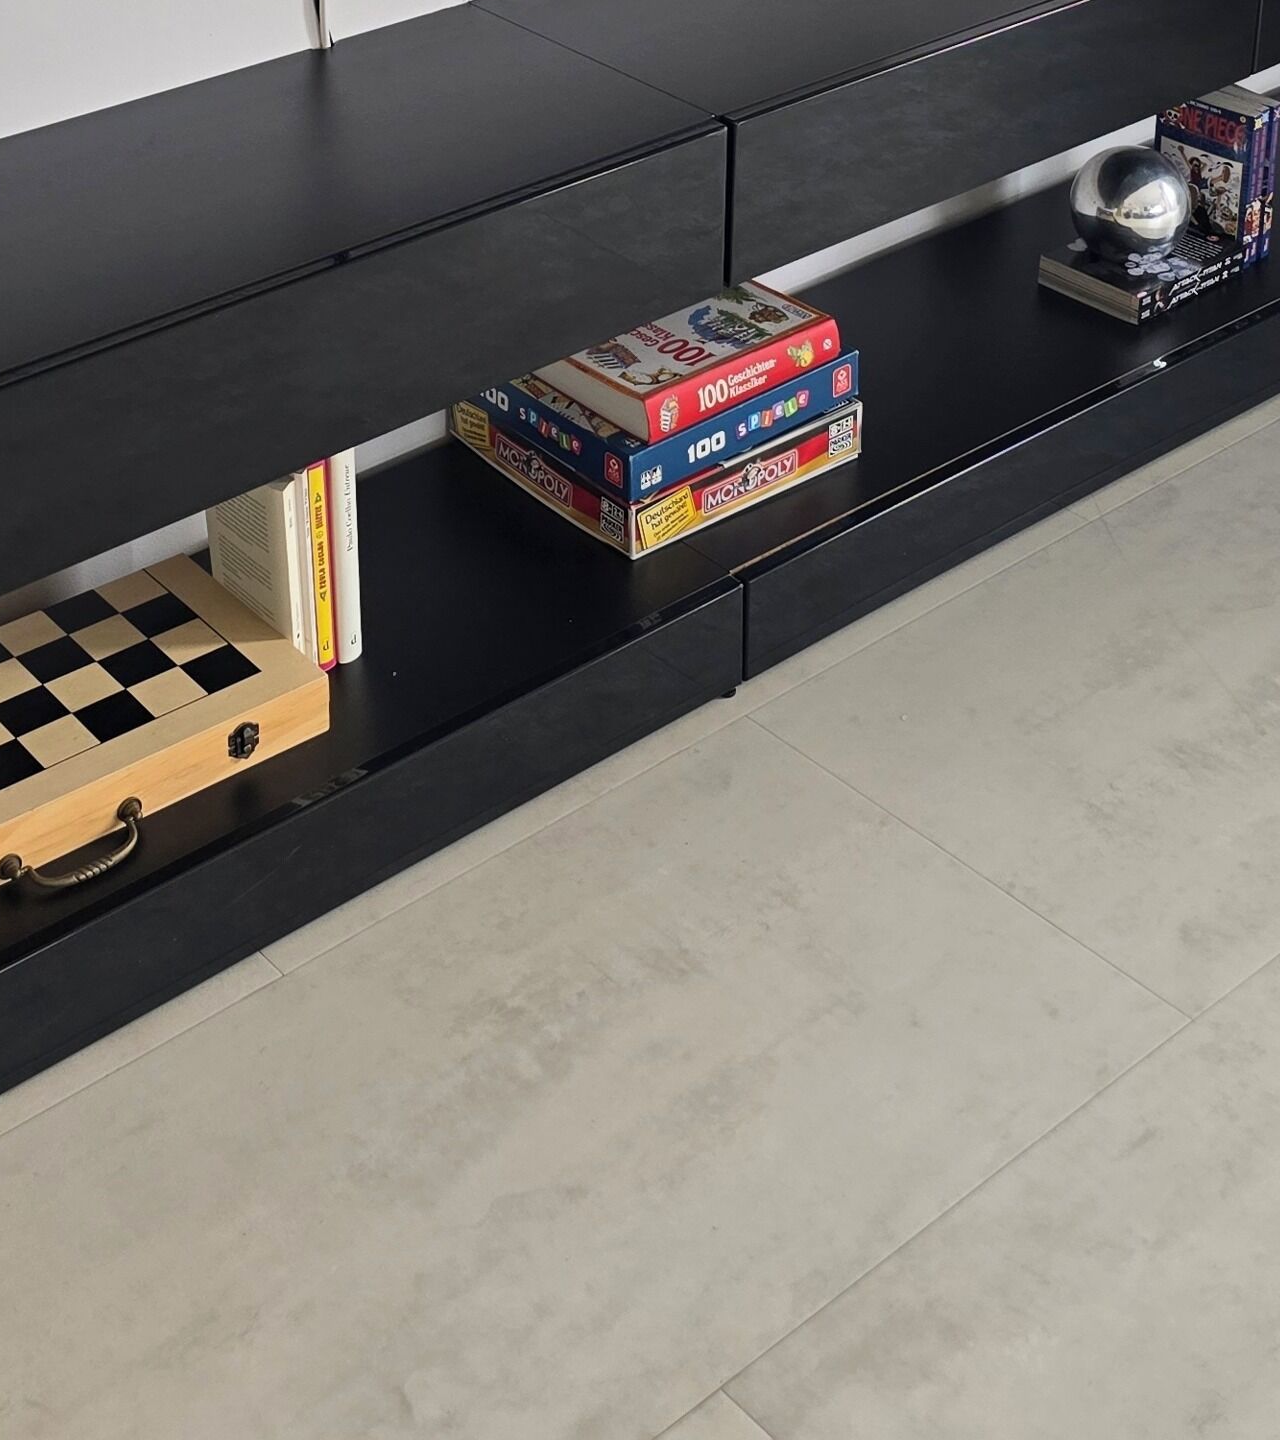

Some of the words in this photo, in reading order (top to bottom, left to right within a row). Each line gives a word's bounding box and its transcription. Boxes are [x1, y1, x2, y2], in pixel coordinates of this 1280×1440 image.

[657, 339, 717, 366] 100
[697, 379, 729, 412] 100
[729, 375, 768, 398] Klassiker
[687, 430, 726, 464] 100
[498, 444, 569, 501] MONOPOLY
[705, 456, 796, 510] MONOPOLY
[645, 492, 689, 525] Deutschland
